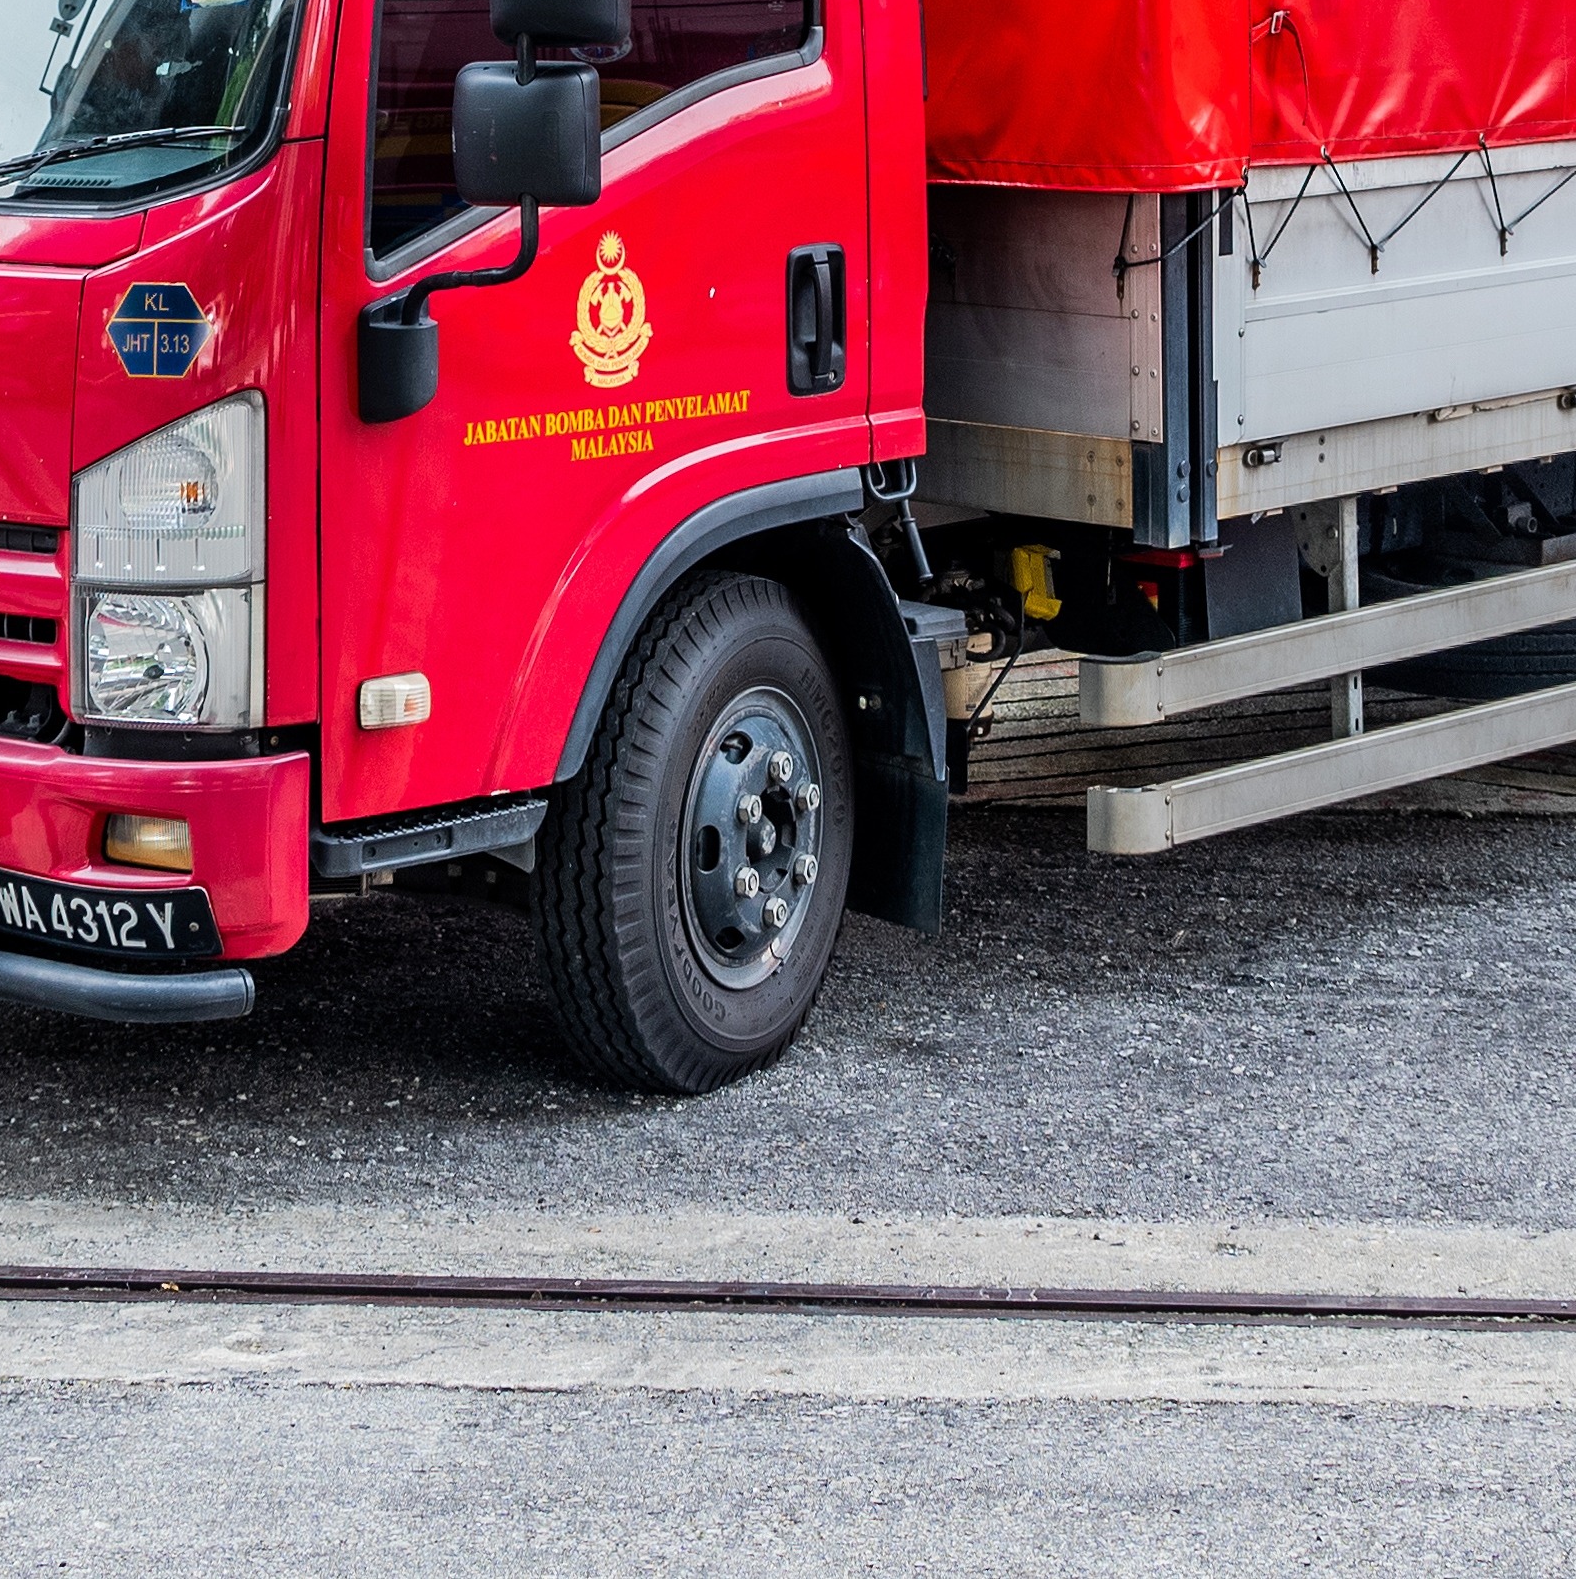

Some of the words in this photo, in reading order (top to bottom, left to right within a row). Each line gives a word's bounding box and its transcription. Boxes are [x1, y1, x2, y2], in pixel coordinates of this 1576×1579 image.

[144, 293, 169, 311] KL
[122, 333, 150, 353] JHT
[160, 333, 190, 353] 3.13
[464, 416, 541, 446] JABATAN
[544, 408, 605, 437] BOMBA
[608, 401, 643, 429] DAN
[645, 390, 751, 424] PENYELAMAT
[570, 430, 654, 461] MALAYSIA
